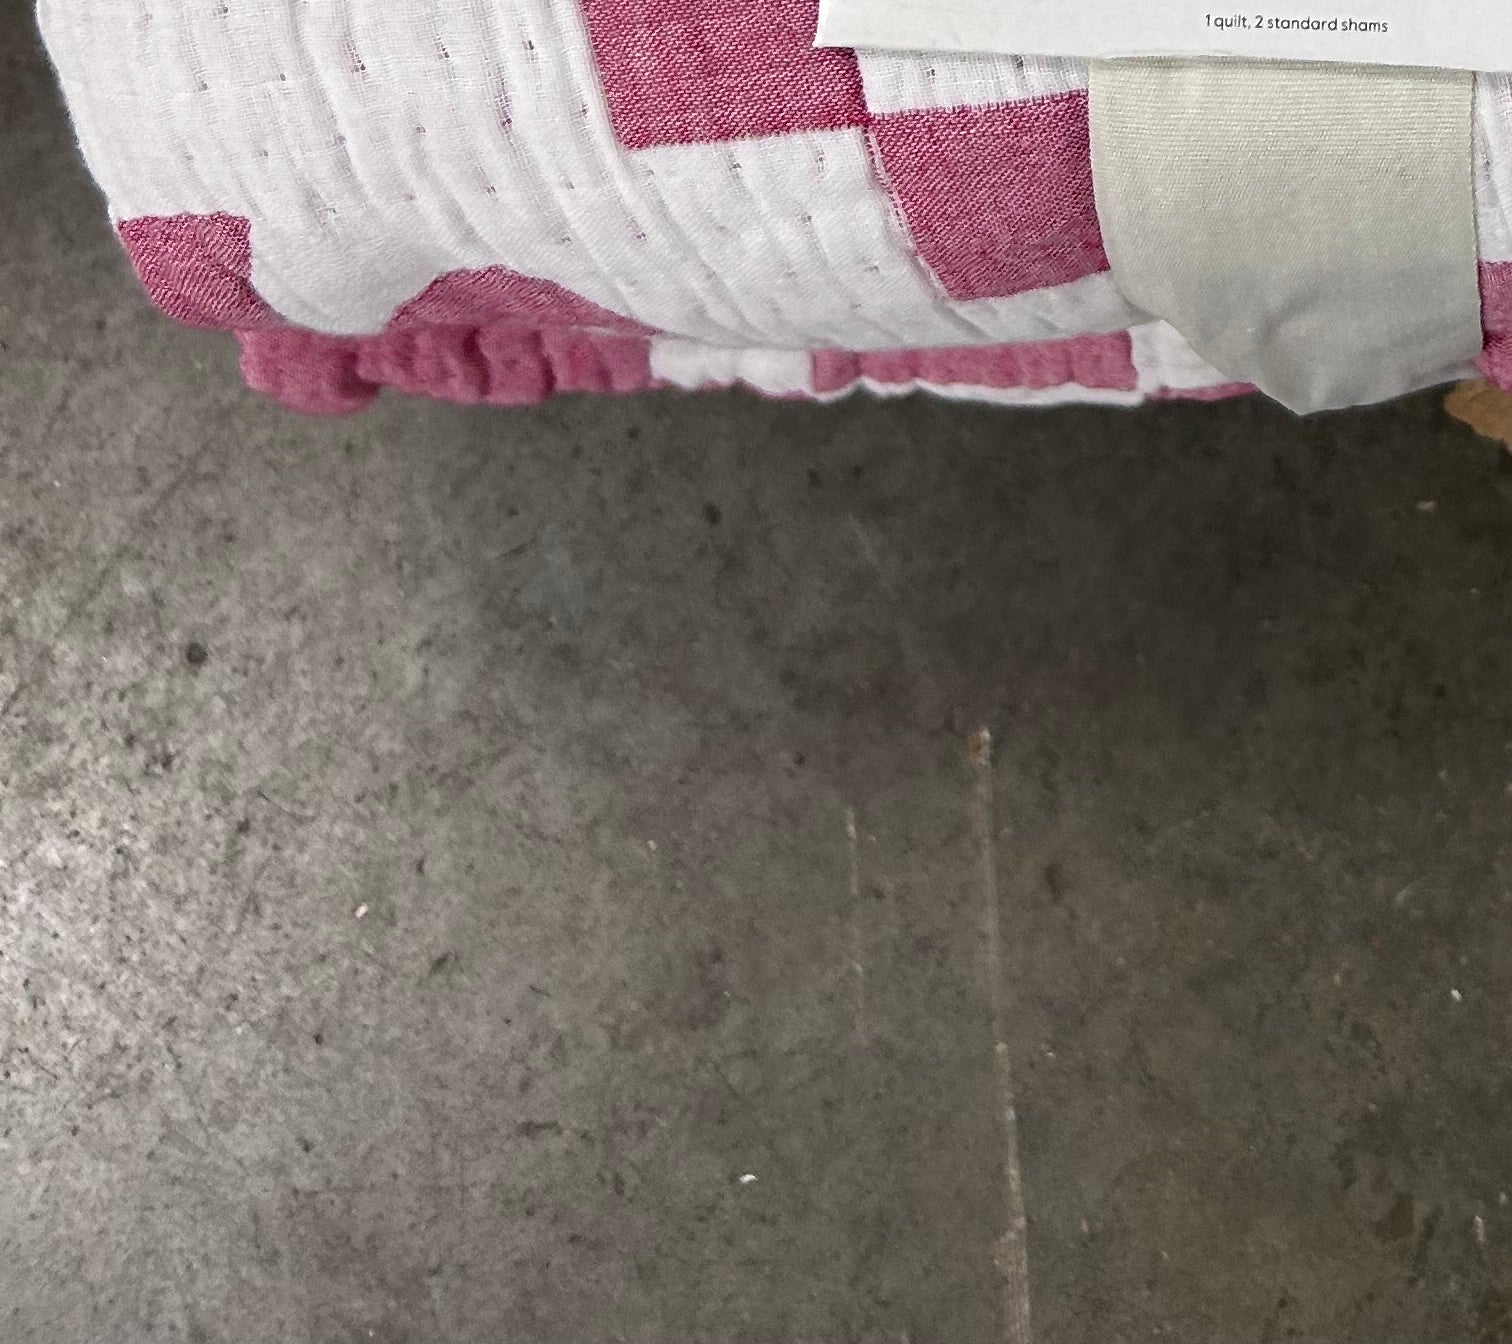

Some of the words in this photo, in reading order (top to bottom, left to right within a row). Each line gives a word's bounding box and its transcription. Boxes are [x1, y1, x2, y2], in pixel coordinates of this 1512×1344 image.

[1254, 14, 1264, 29] 2
[1267, 15, 1338, 32] standard
[1341, 17, 1389, 33] shams
